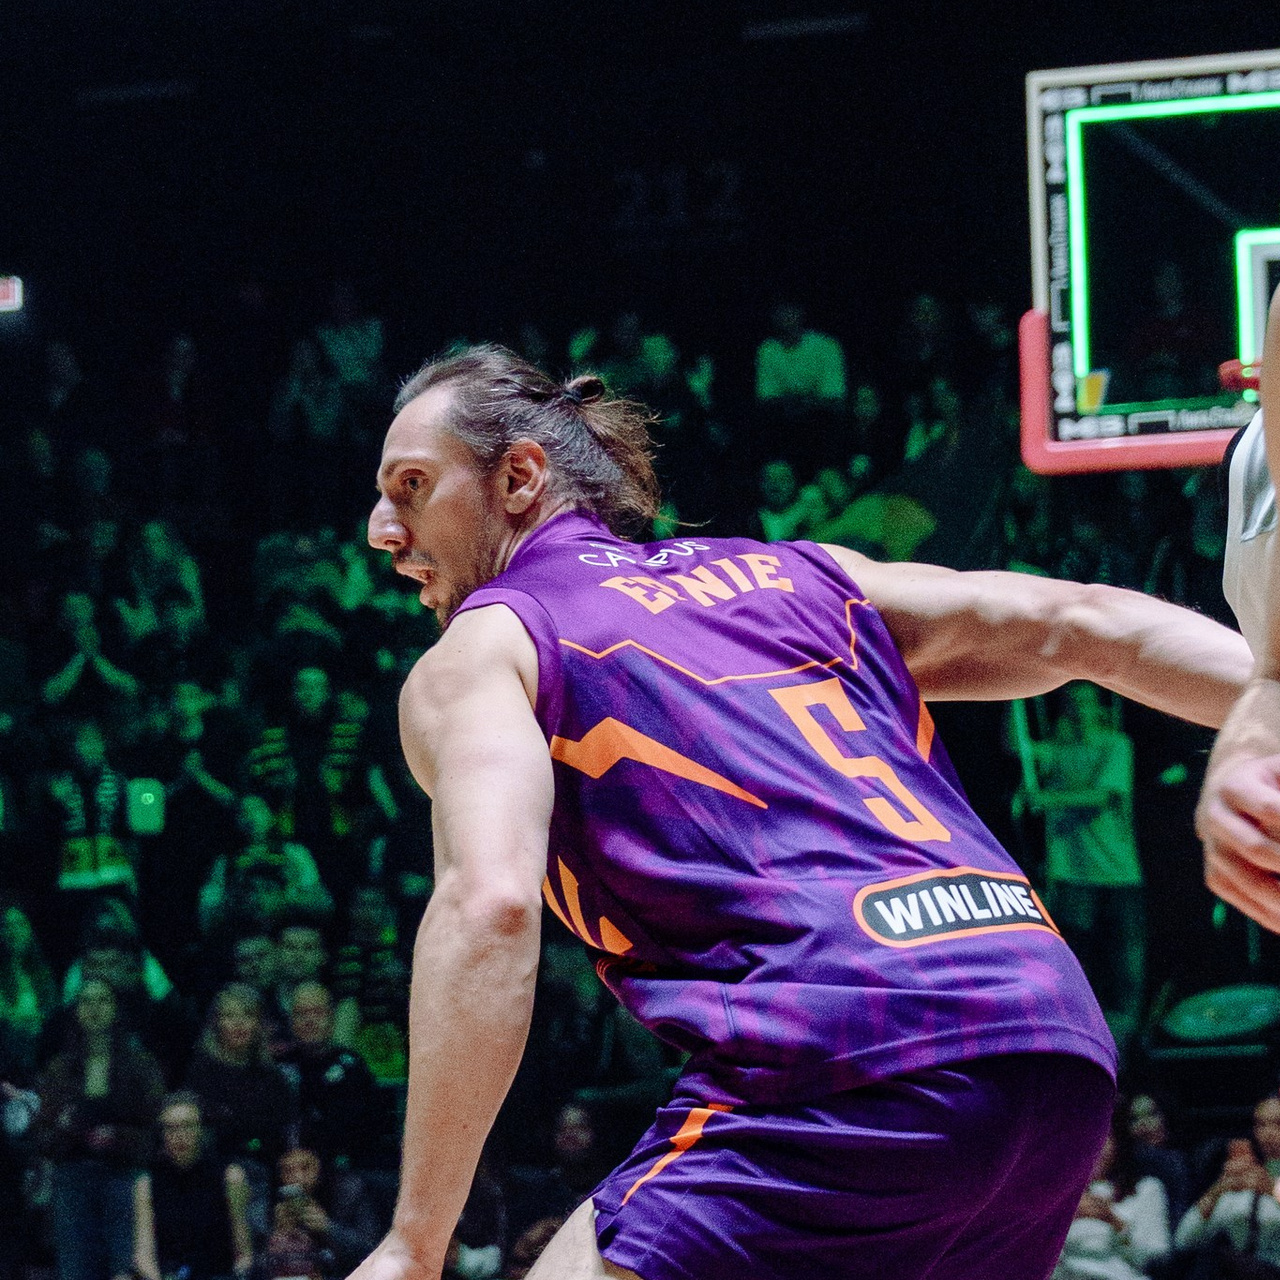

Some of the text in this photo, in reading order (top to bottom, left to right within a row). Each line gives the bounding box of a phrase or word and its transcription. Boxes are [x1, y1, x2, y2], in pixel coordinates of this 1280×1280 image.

[579, 541, 711, 567] CAPUS
[767, 677, 951, 842] 5
[874, 880, 1042, 934] WINLINE
